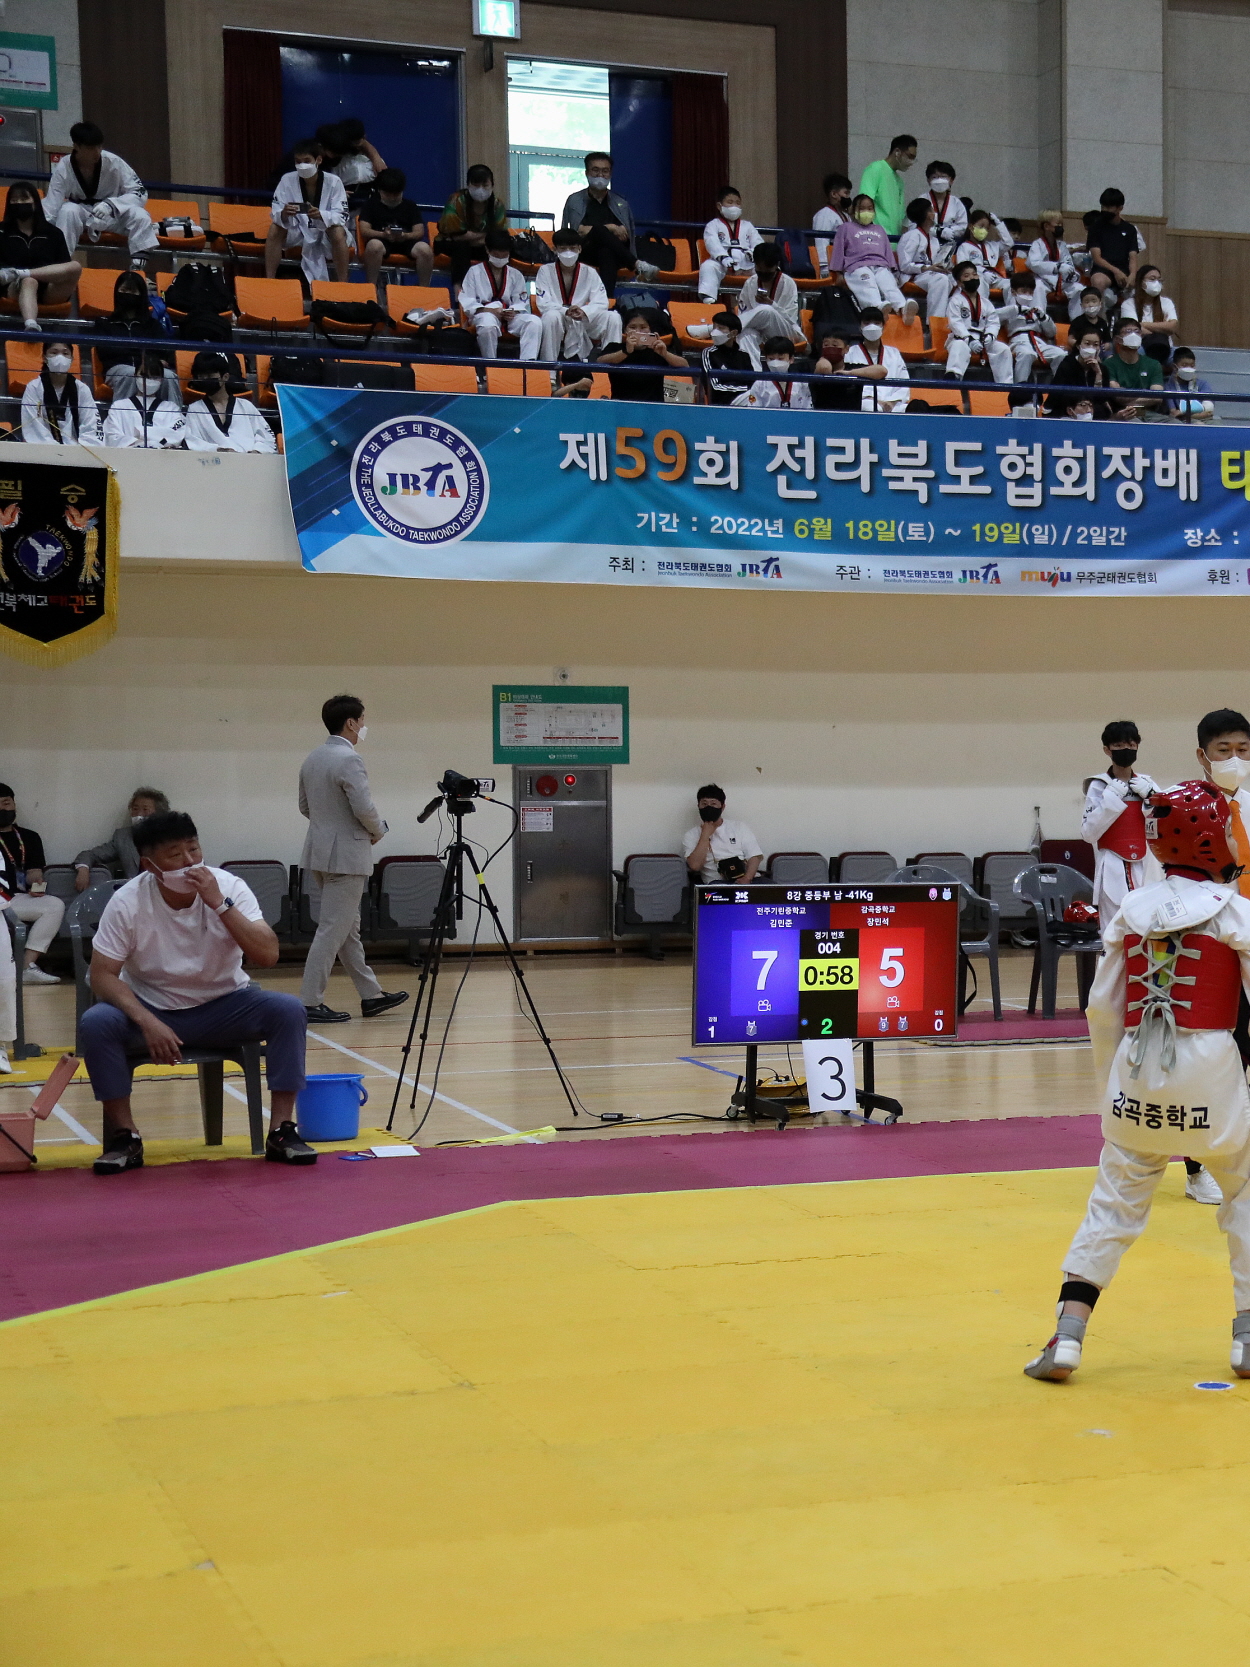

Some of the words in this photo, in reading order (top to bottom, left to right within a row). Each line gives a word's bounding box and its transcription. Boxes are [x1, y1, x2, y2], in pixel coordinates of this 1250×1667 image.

[361, 423, 477, 472] 전라북도태권도협회
[360, 468, 372, 485] THE
[558, 426, 739, 491] 제59회
[765, 435, 1199, 511] 전라북도협회장배
[381, 462, 461, 498] JBTA
[461, 471, 480, 526] ASSOCIATION
[361, 486, 407, 536] JEOLLABUKDO
[408, 521, 461, 541] TAEKWONDO
[636, 512, 680, 533] 기간
[710, 515, 784, 538] 2022년
[794, 517, 833, 540] 6월
[844, 519, 935, 543] 18일(토)
[1183, 528, 1223, 548] 장소
[608, 556, 635, 573] 주최
[657, 561, 732, 573] 전라북도태권도협회
[736, 556, 783, 579] JBTA
[835, 564, 861, 581] 주관
[883, 569, 953, 579] 전라북도태권도협회
[958, 562, 1001, 584] JBTA
[1075, 571, 1158, 584] 무주군태권도협회
[1207, 569, 1230, 585] 후원
[786, 891, 802, 901] 8강
[804, 890, 831, 901] 중등부
[834, 890, 842, 901] 남
[845, 890, 874, 901] -41Kg
[756, 906, 807, 916] 전주기린중학교
[814, 931, 828, 940] 경기
[831, 931, 845, 939] 번호
[817, 942, 841, 954] 004
[752, 950, 778, 991] 7
[804, 965, 854, 986] 0:58
[878, 948, 905, 988] 5
[708, 1025, 715, 1038] 1
[820, 1018, 833, 1035] 2
[934, 1019, 944, 1031] 0
[817, 1056, 847, 1101] 3
